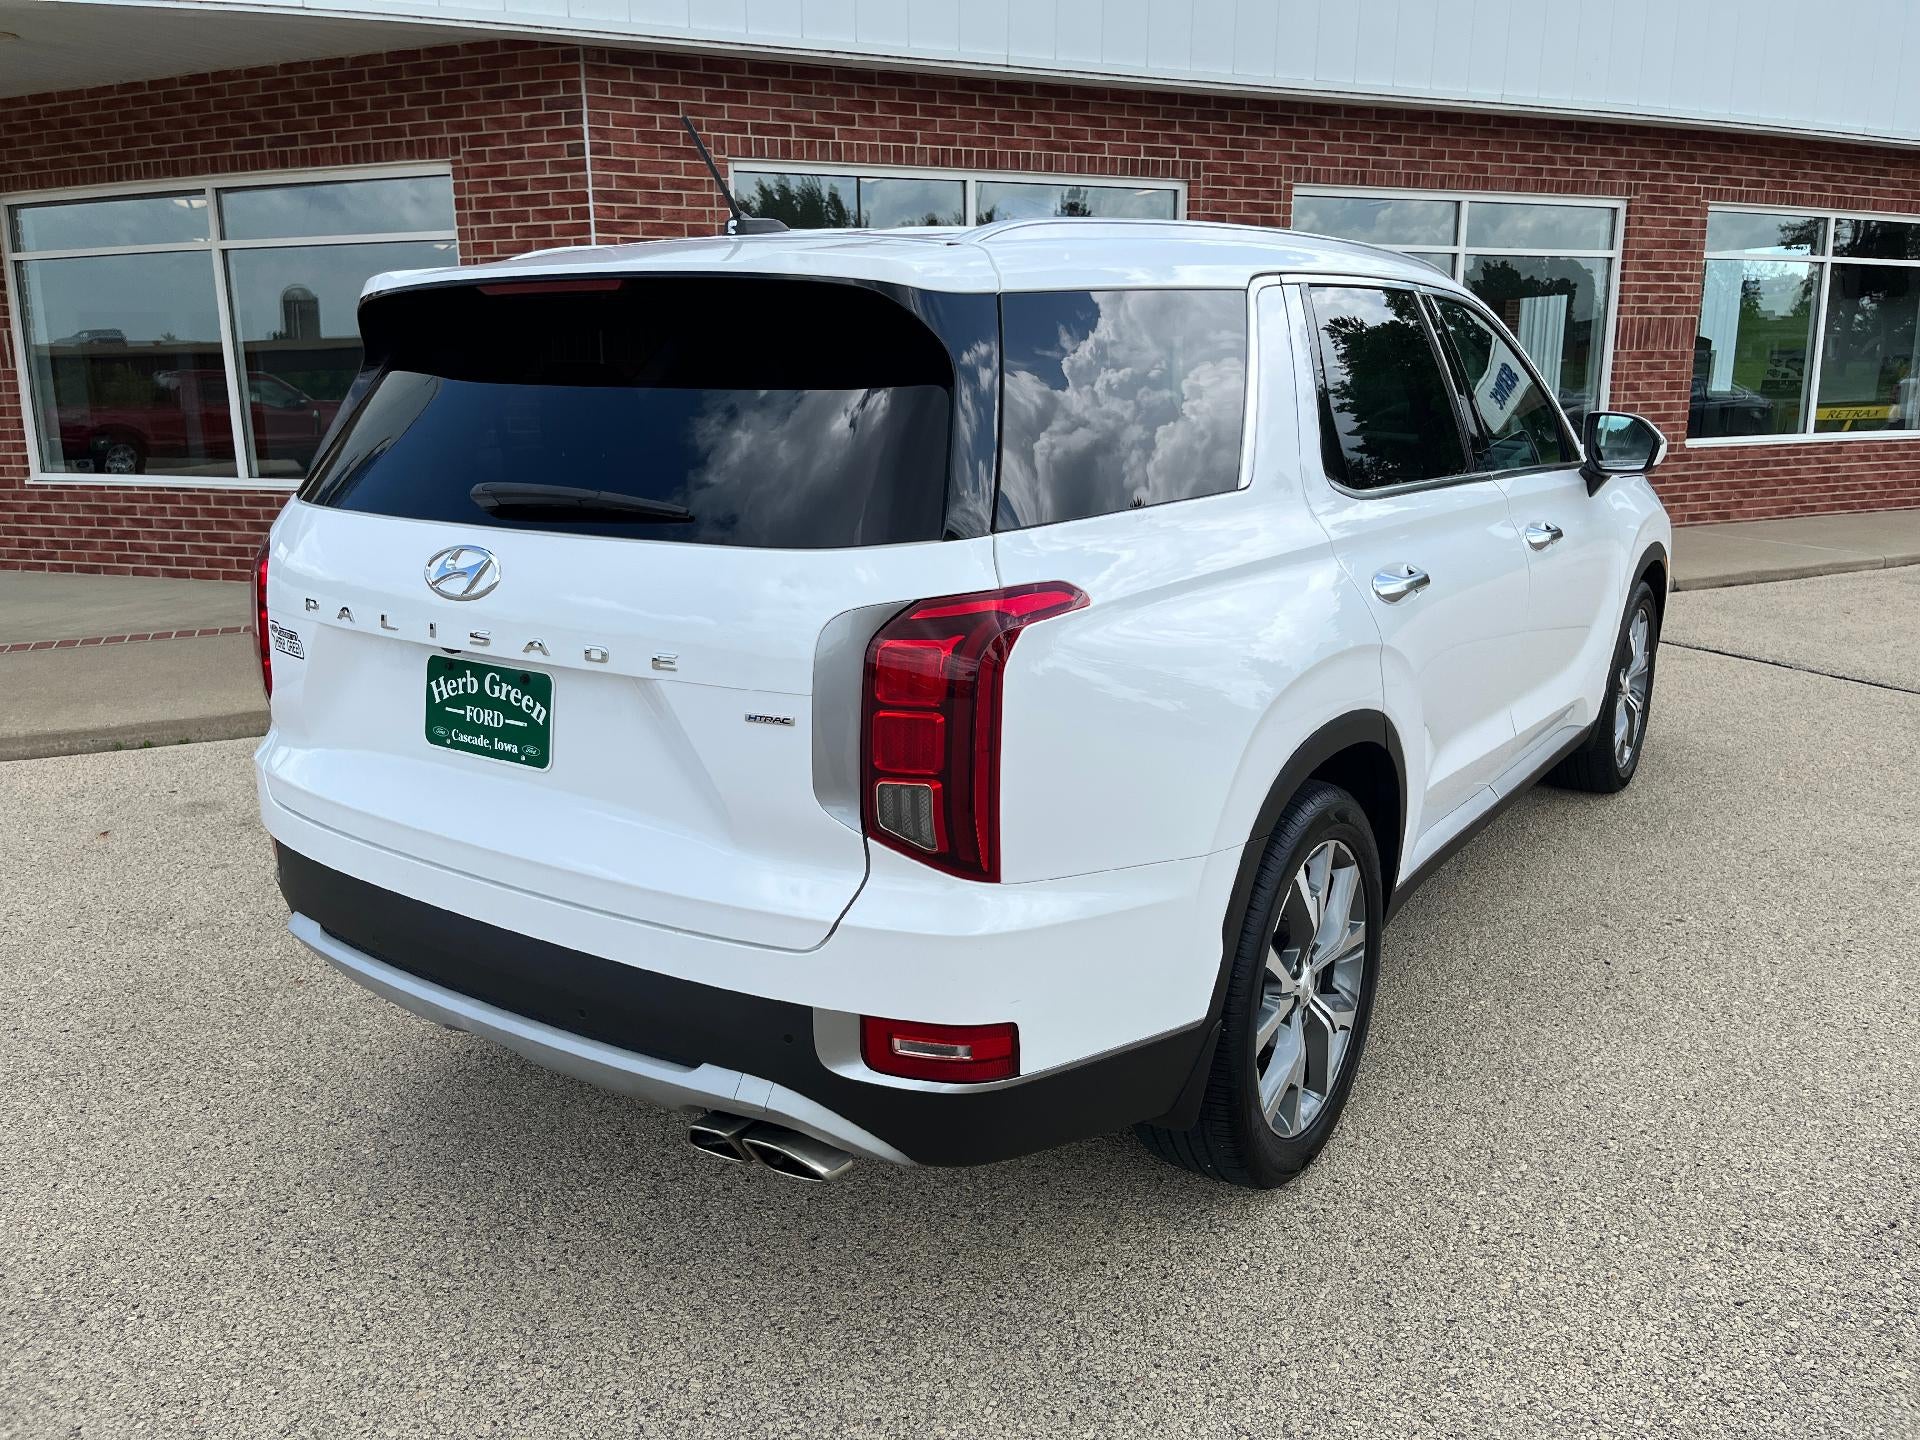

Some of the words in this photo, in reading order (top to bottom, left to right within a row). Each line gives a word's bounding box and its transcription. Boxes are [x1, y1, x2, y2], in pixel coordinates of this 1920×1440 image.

[1826, 409, 1881, 419] RETRAX
[305, 597, 679, 672] PALISADE
[430, 669, 478, 704] Herb
[484, 672, 547, 726] Green
[465, 705, 504, 728] FORD
[747, 714, 791, 725] HTRAC
[451, 728, 492, 750] Cascade,
[494, 737, 518, 754] Iowa
